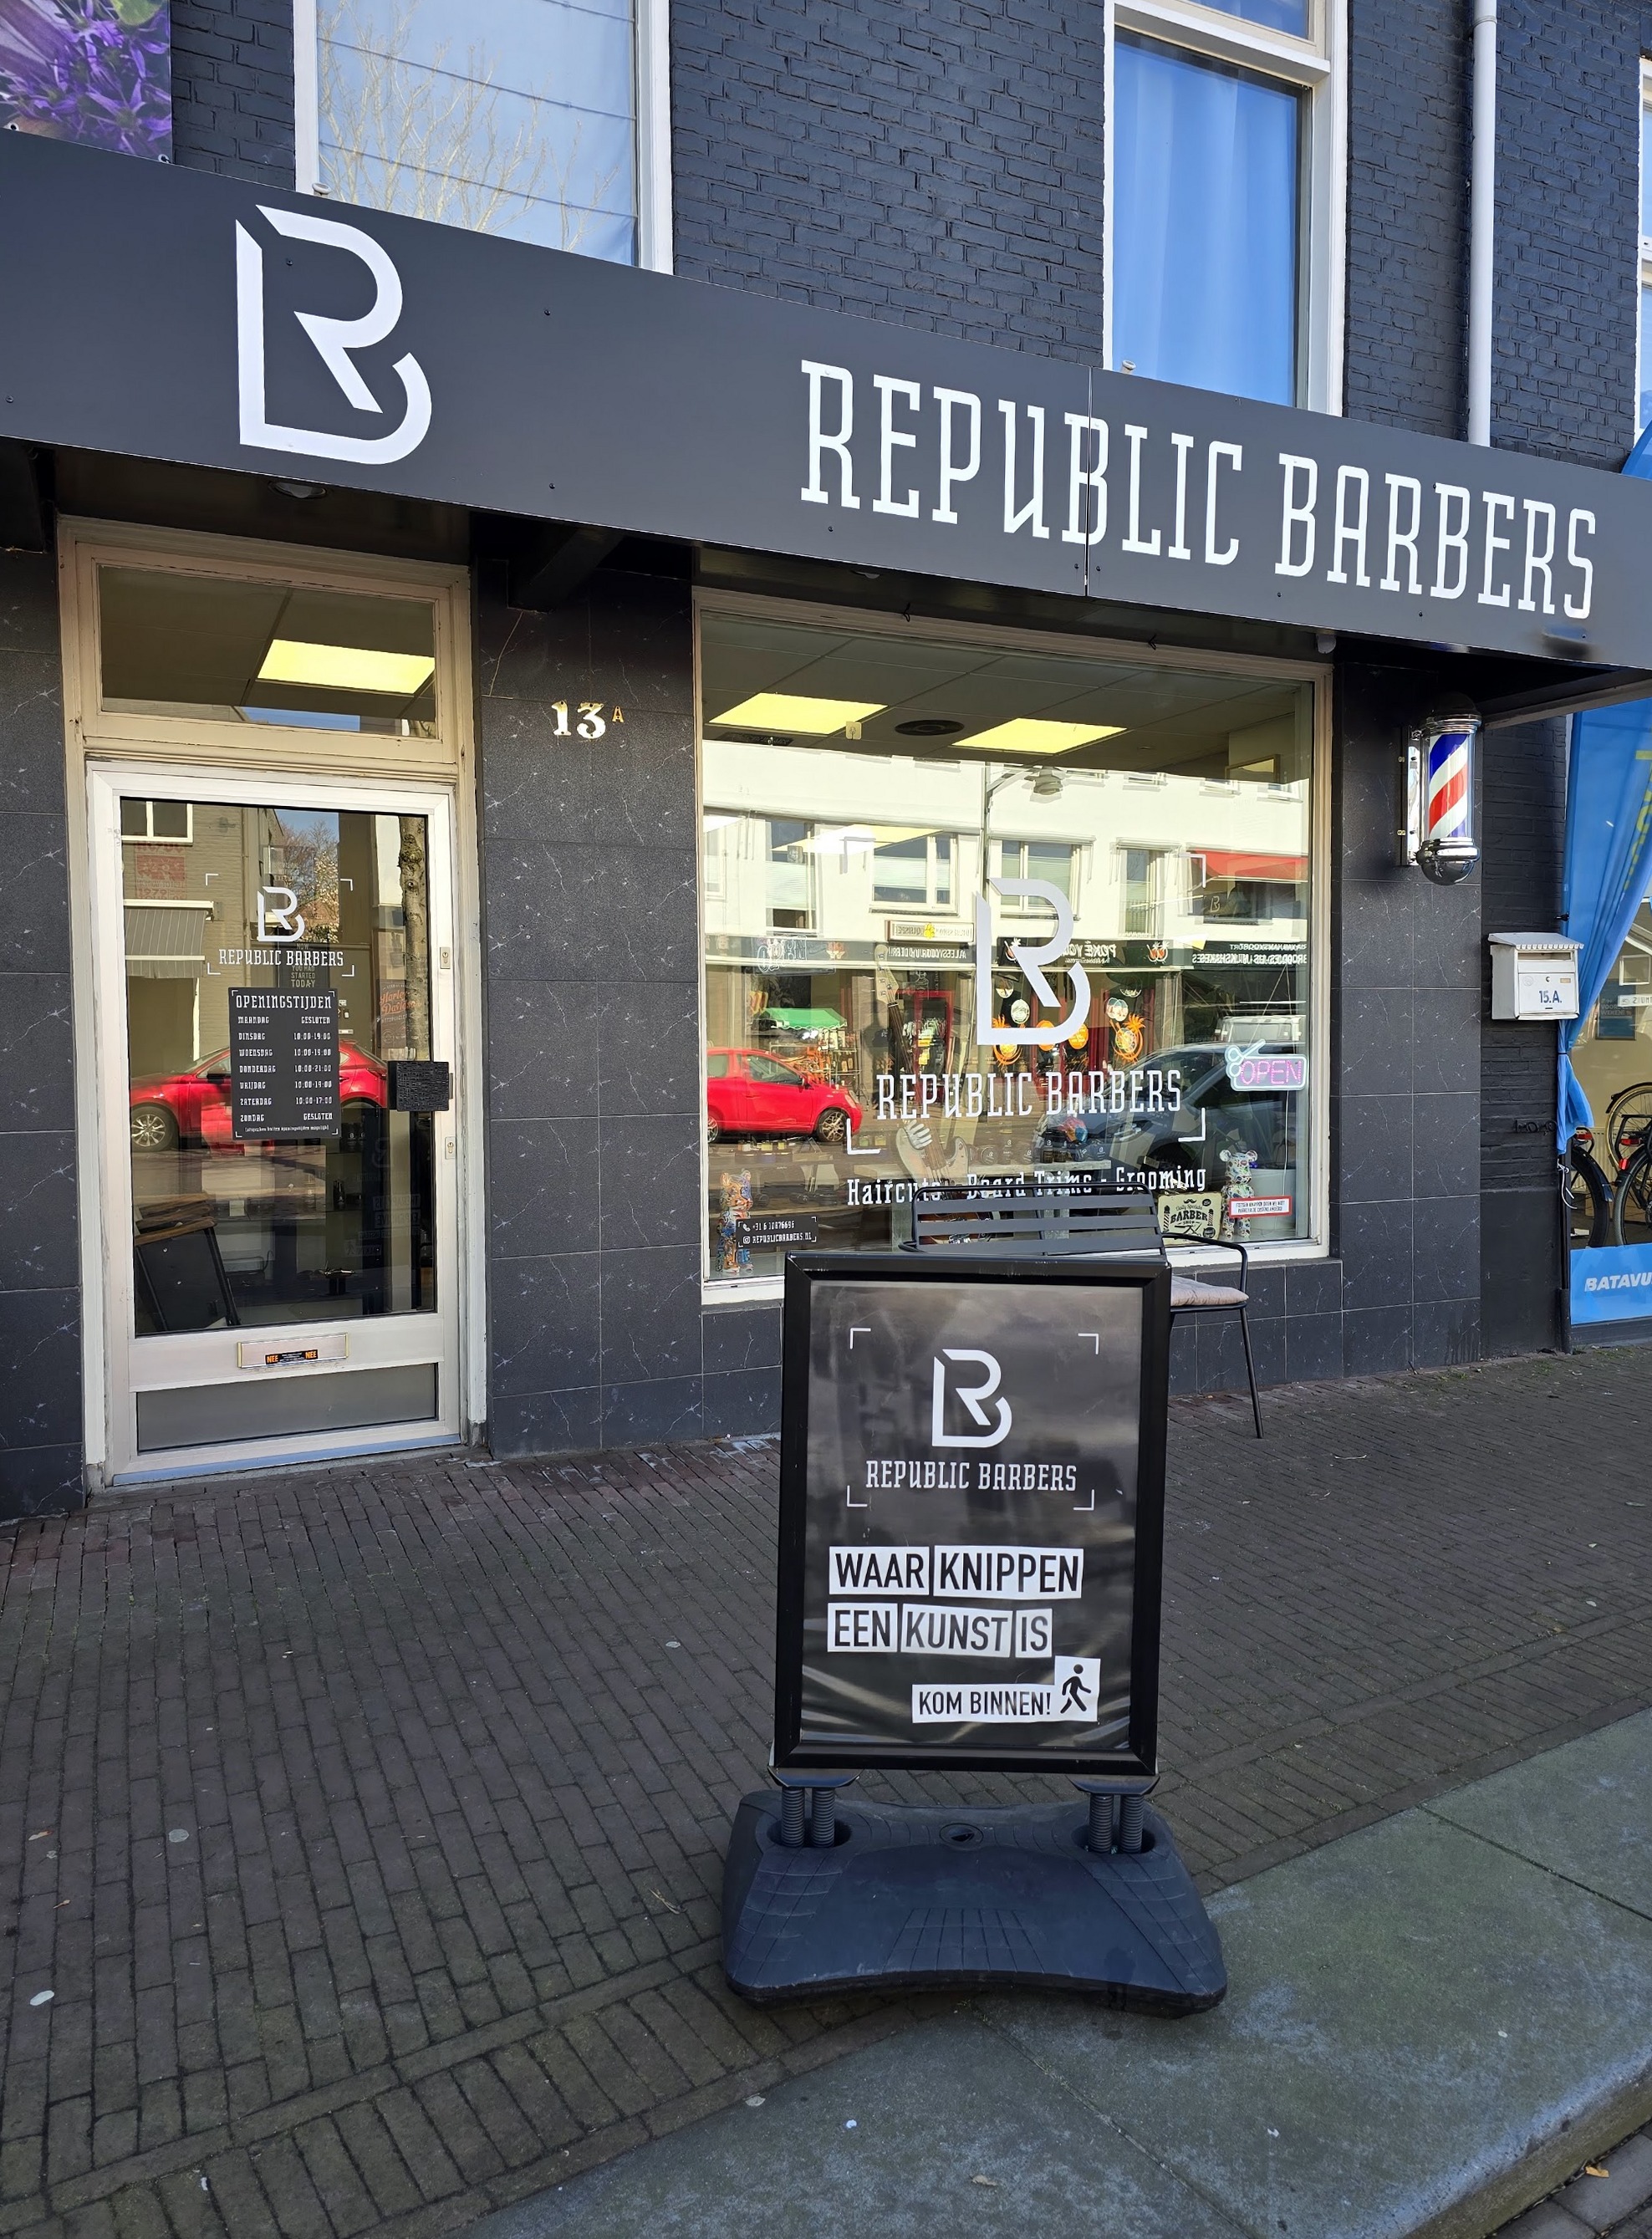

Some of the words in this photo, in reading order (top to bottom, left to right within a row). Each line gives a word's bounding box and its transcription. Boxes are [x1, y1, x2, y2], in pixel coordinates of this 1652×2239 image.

[801, 360, 1242, 565] REPUBLIC
[1275, 452, 1595, 619] BARBERS
[551, 700, 606, 739] 13
[218, 948, 282, 965] REPUBLIC
[286, 951, 344, 966] BARBERS
[236, 995, 332, 1010] OPENINGSTIJDEN
[237, 1016, 269, 1024] MAANDAG
[301, 1016, 330, 1024] GESLOTEN
[238, 1032, 265, 1040] DINSDAG
[239, 1048, 273, 1057] WOENSDAG
[1240, 1059, 1302, 1085] OPEN
[240, 1081, 266, 1090] VRIJDAG
[876, 1071, 1032, 1120] REPUBLIC
[1046, 1069, 1181, 1116] BARBERS
[240, 1114, 264, 1122] ZONDAG
[303, 1112, 333, 1120] GESLOTEN
[847, 1177, 942, 1206] Haircuts
[1116, 1165, 1206, 1192] Grooming
[1170, 1210, 1208, 1224] BARBER
[1584, 1272, 1652, 1293] BATAVU
[305, 1351, 317, 1359] NEE
[865, 1460, 970, 1489] REPUBLIC
[977, 1462, 1077, 1492] BARBERS
[835, 1553, 924, 1589] WAAR
[941, 1552, 1078, 1593] KNIPPEN
[834, 1609, 890, 1647] EEN
[906, 1610, 1008, 1651] KUNST
[1021, 1615, 1048, 1652] IS
[919, 1691, 961, 1715] KOM
[970, 1691, 1051, 1716] BINNEN!
